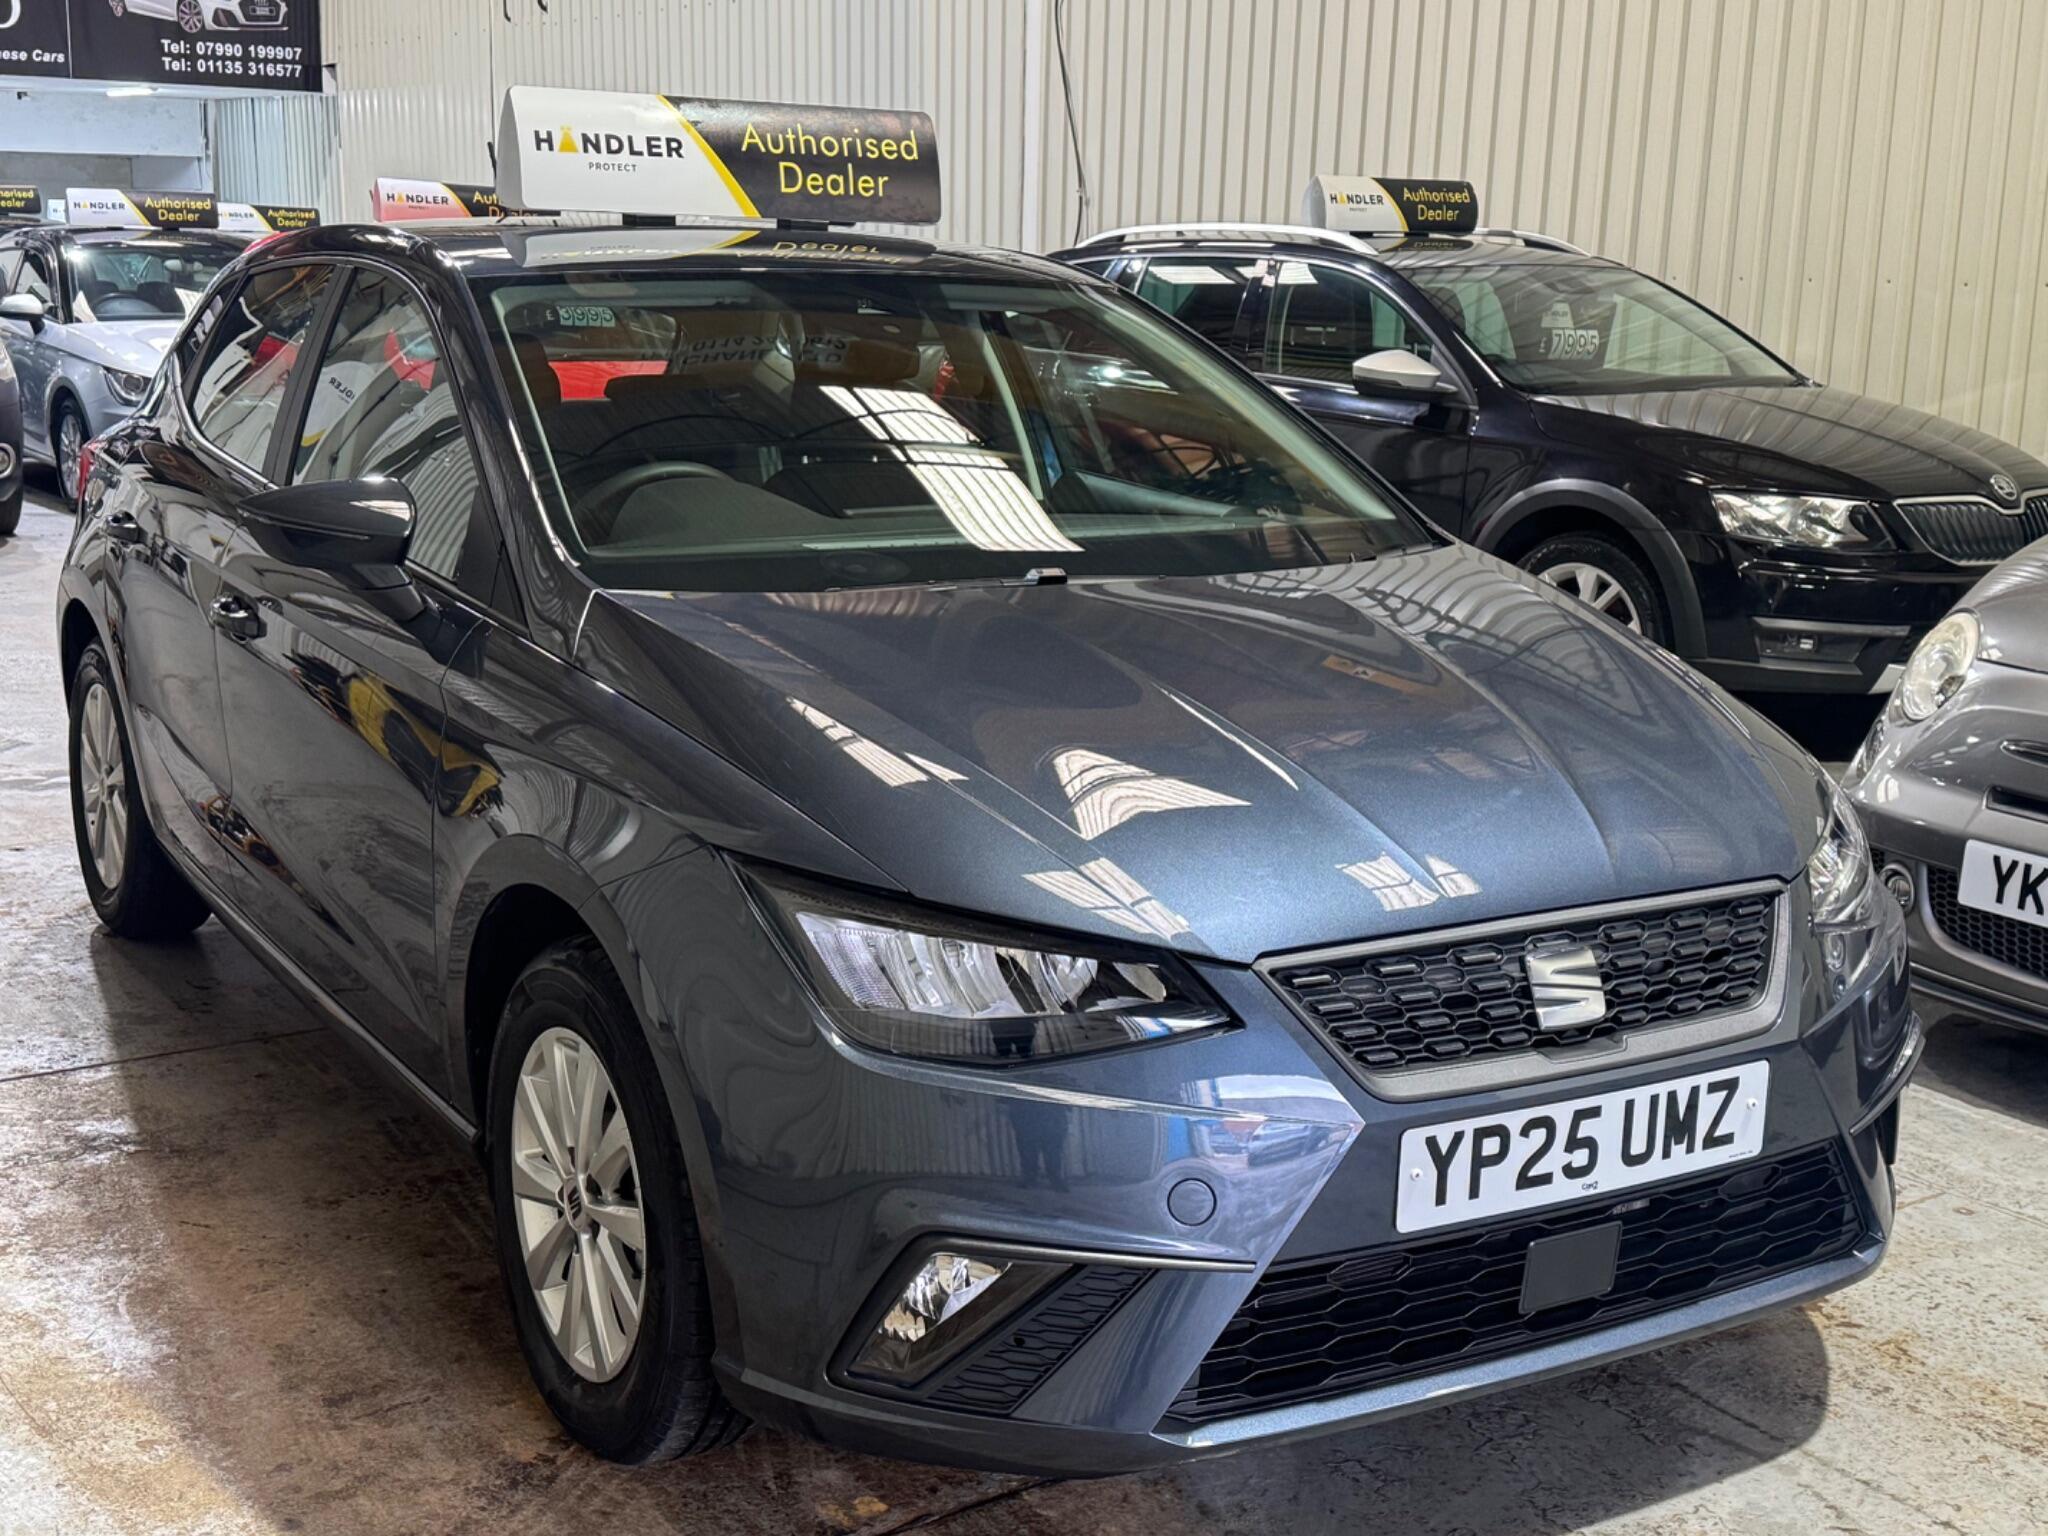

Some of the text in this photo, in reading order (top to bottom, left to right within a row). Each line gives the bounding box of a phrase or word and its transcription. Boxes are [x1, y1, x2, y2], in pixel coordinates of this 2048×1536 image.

[32, 49, 66, 62] Cars
[161, 39, 302, 60] Tel: 07990 199907
[162, 57, 302, 78] Tel: 01135 316577
[741, 122, 919, 161] Authorised
[588, 162, 638, 172] PROTECT
[778, 161, 889, 197] Dealer
[145, 196, 212, 211] Authorised
[1403, 187, 1471, 204] Authorised
[158, 209, 200, 222] Dealer
[267, 208, 316, 219] Authorised
[1417, 205, 1460, 222] Dealer
[276, 217, 308, 228] Dealer
[1992, 854, 2048, 916] YK
[1425, 1076, 1741, 1207] YP25 UMZ
